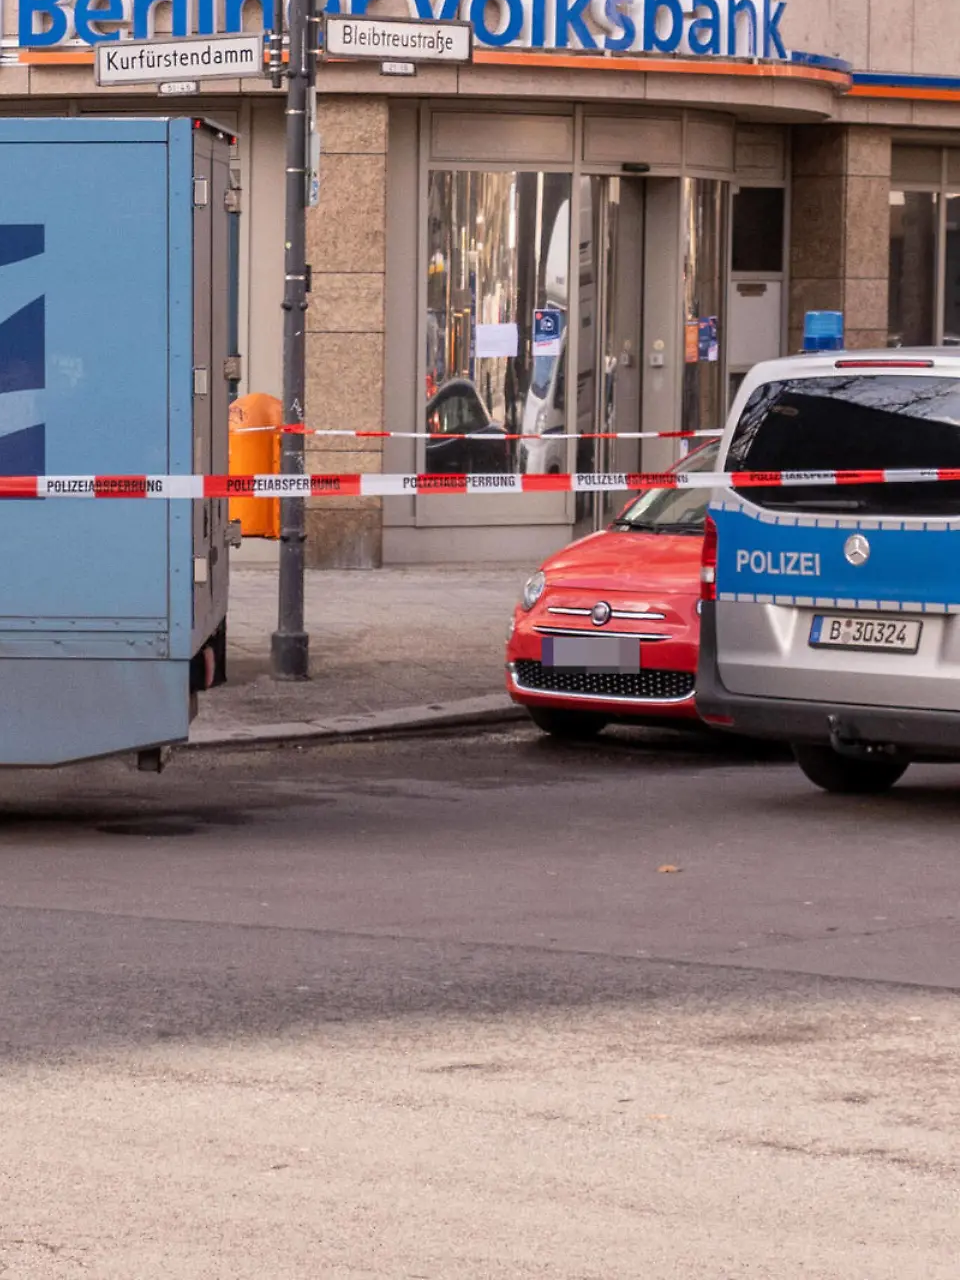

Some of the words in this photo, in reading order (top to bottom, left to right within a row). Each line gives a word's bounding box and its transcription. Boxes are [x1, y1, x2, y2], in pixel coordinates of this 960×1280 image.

[342, 24, 454, 54] Bleibtreustraße
[107, 45, 253, 71] Kurfürstendamm
[47, 480, 163, 493] POLIZEIABSPERRUNG
[227, 478, 340, 492] POLIZEIABSPERRUNG
[403, 476, 515, 488] POLIZEIABSPERRUNG
[577, 474, 688, 485] POLIZEIABSPERRUNG
[737, 549, 821, 576] POLIZEI
[829, 621, 840, 640] B
[852, 623, 907, 644] 30324
